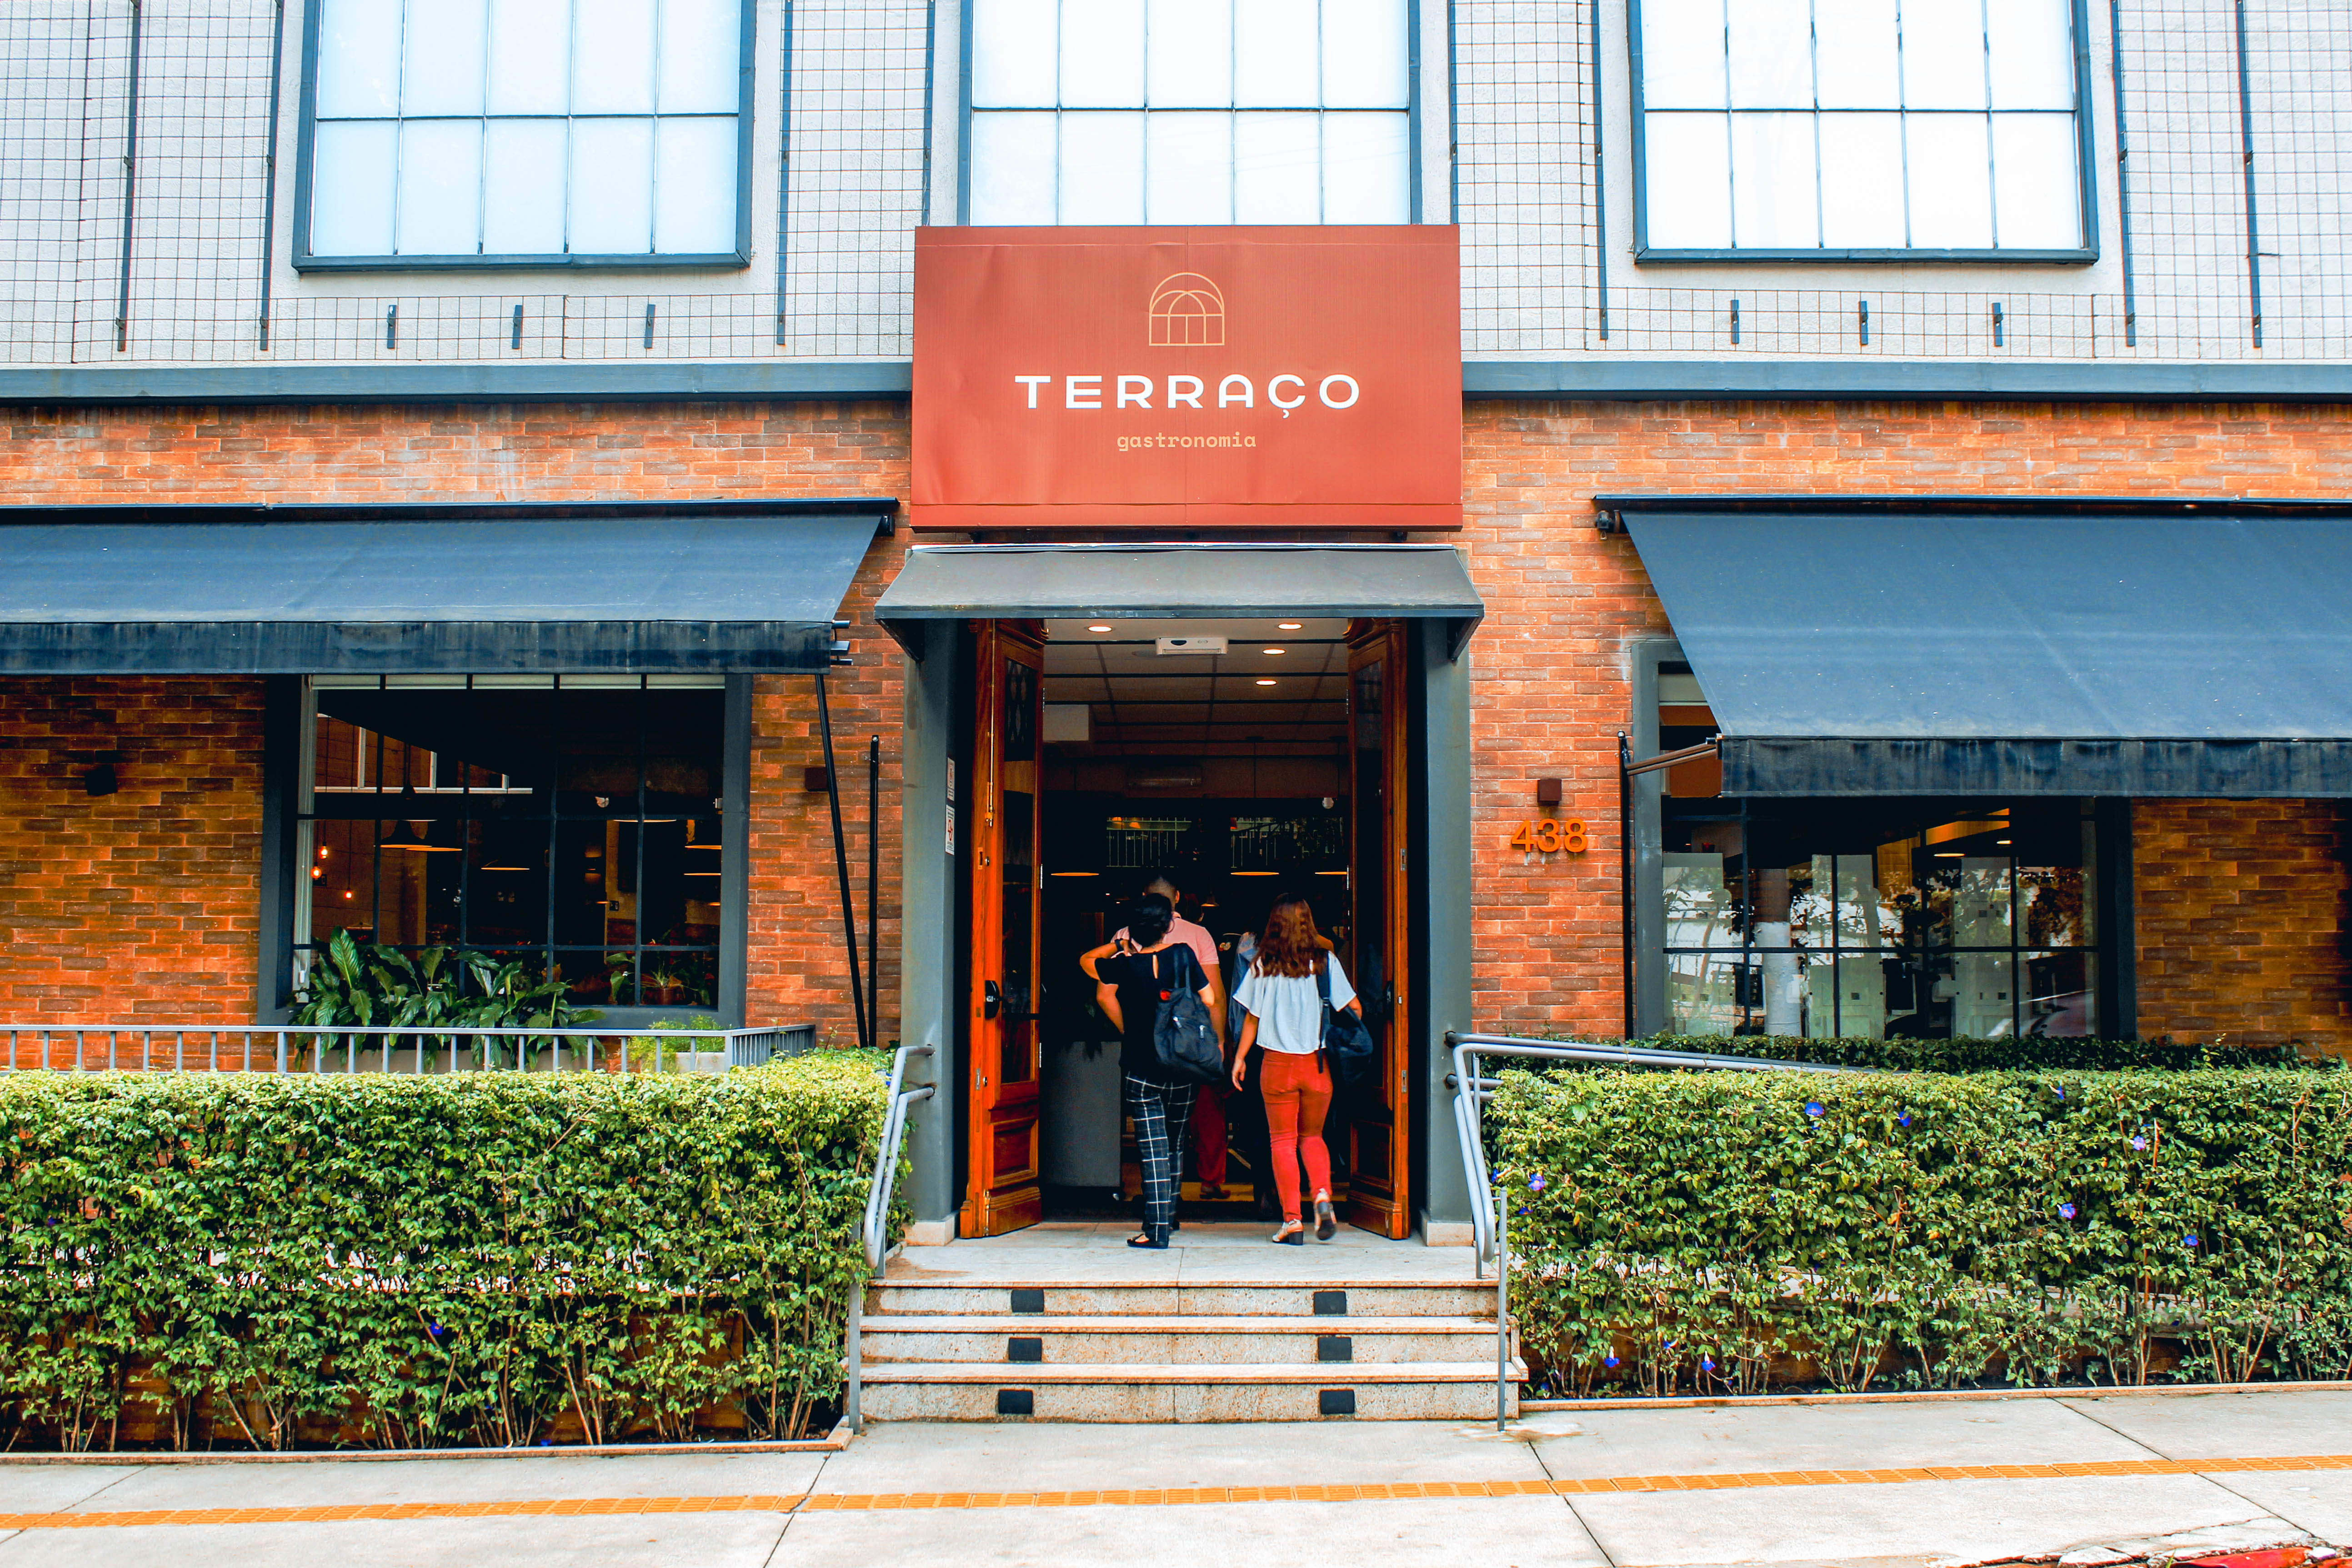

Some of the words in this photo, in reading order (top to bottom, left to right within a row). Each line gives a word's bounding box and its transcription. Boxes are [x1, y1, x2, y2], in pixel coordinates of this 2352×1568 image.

[1015, 374, 1359, 419] TERRAÇO
[1117, 431, 1256, 451] gastronomia
[1511, 818, 1588, 853] 438
